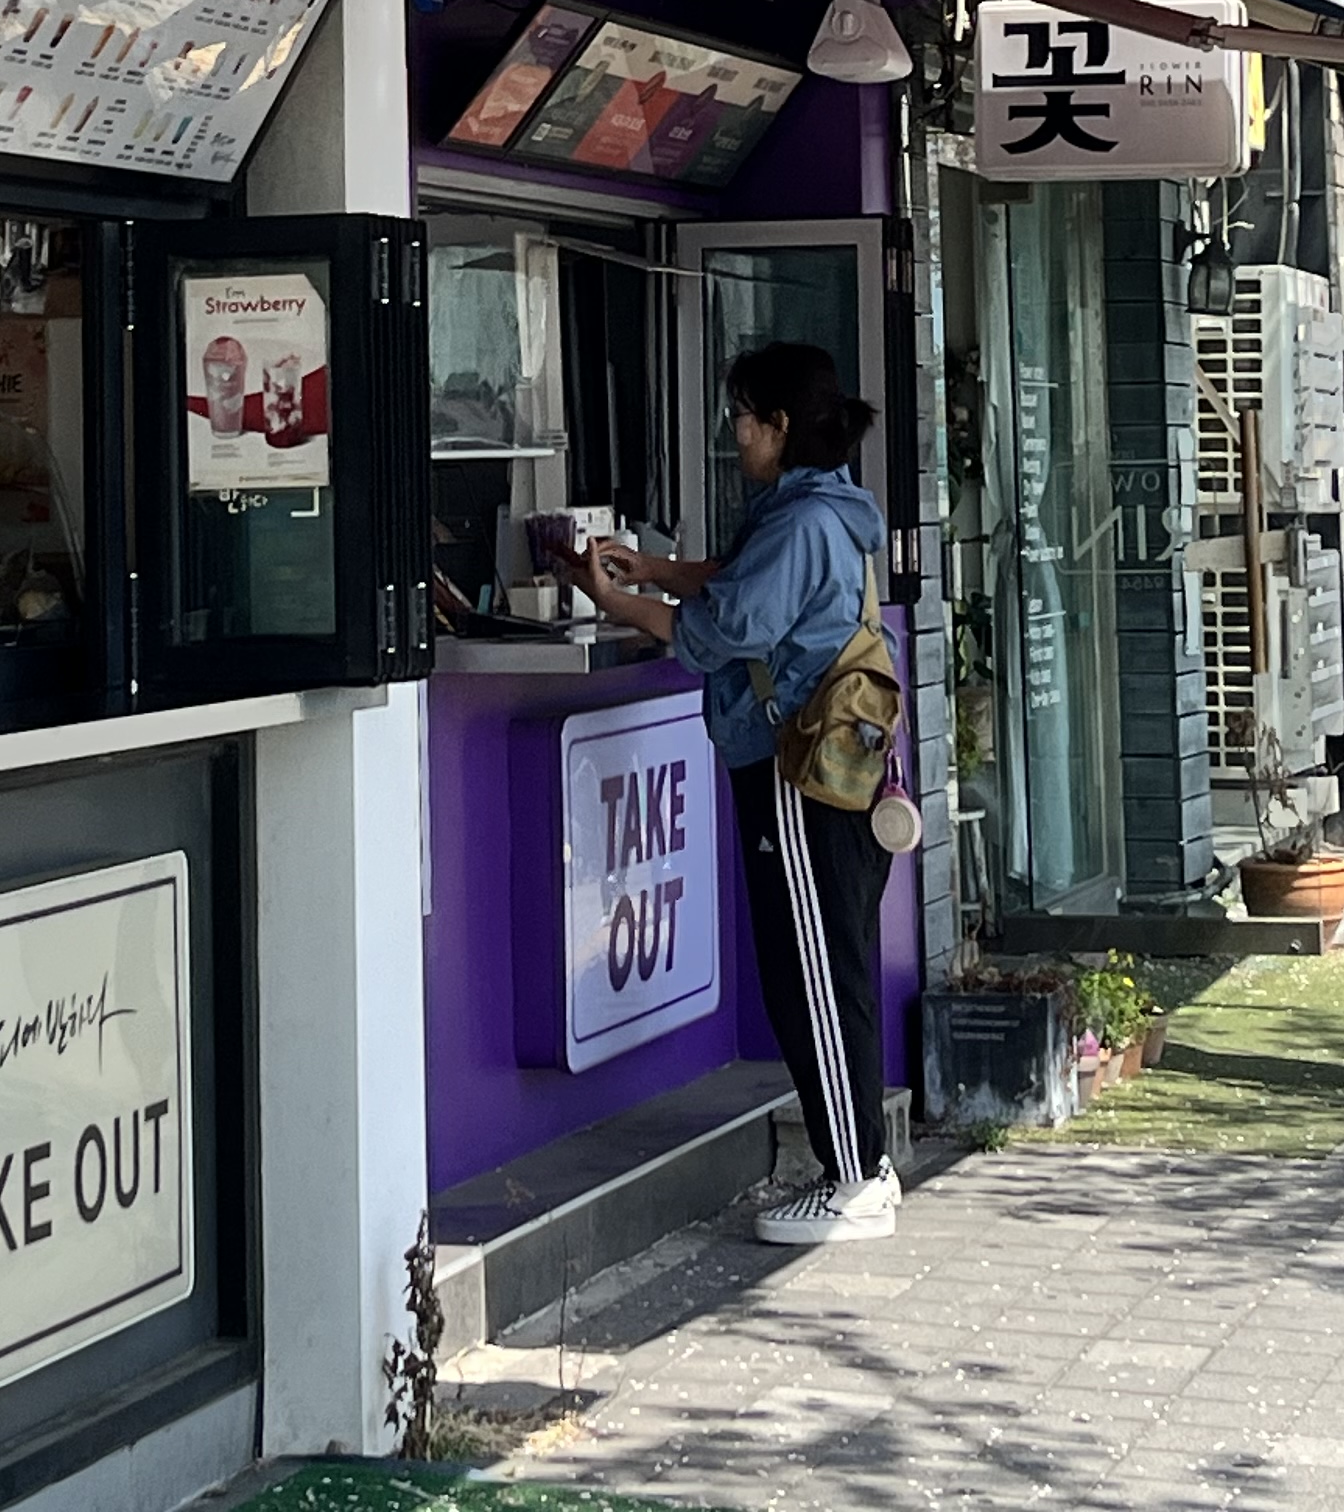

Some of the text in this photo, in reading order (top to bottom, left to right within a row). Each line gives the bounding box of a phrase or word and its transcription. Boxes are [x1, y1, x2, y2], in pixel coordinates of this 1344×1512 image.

[991, 20, 1127, 155] 꽃
[1139, 61, 1202, 70] FLOWER
[1139, 73, 1203, 97] RIN
[205, 296, 307, 317] Strawberry
[600, 758, 687, 872] TAKE
[607, 878, 684, 994] OUT
[73, 1098, 169, 1225] OUT
